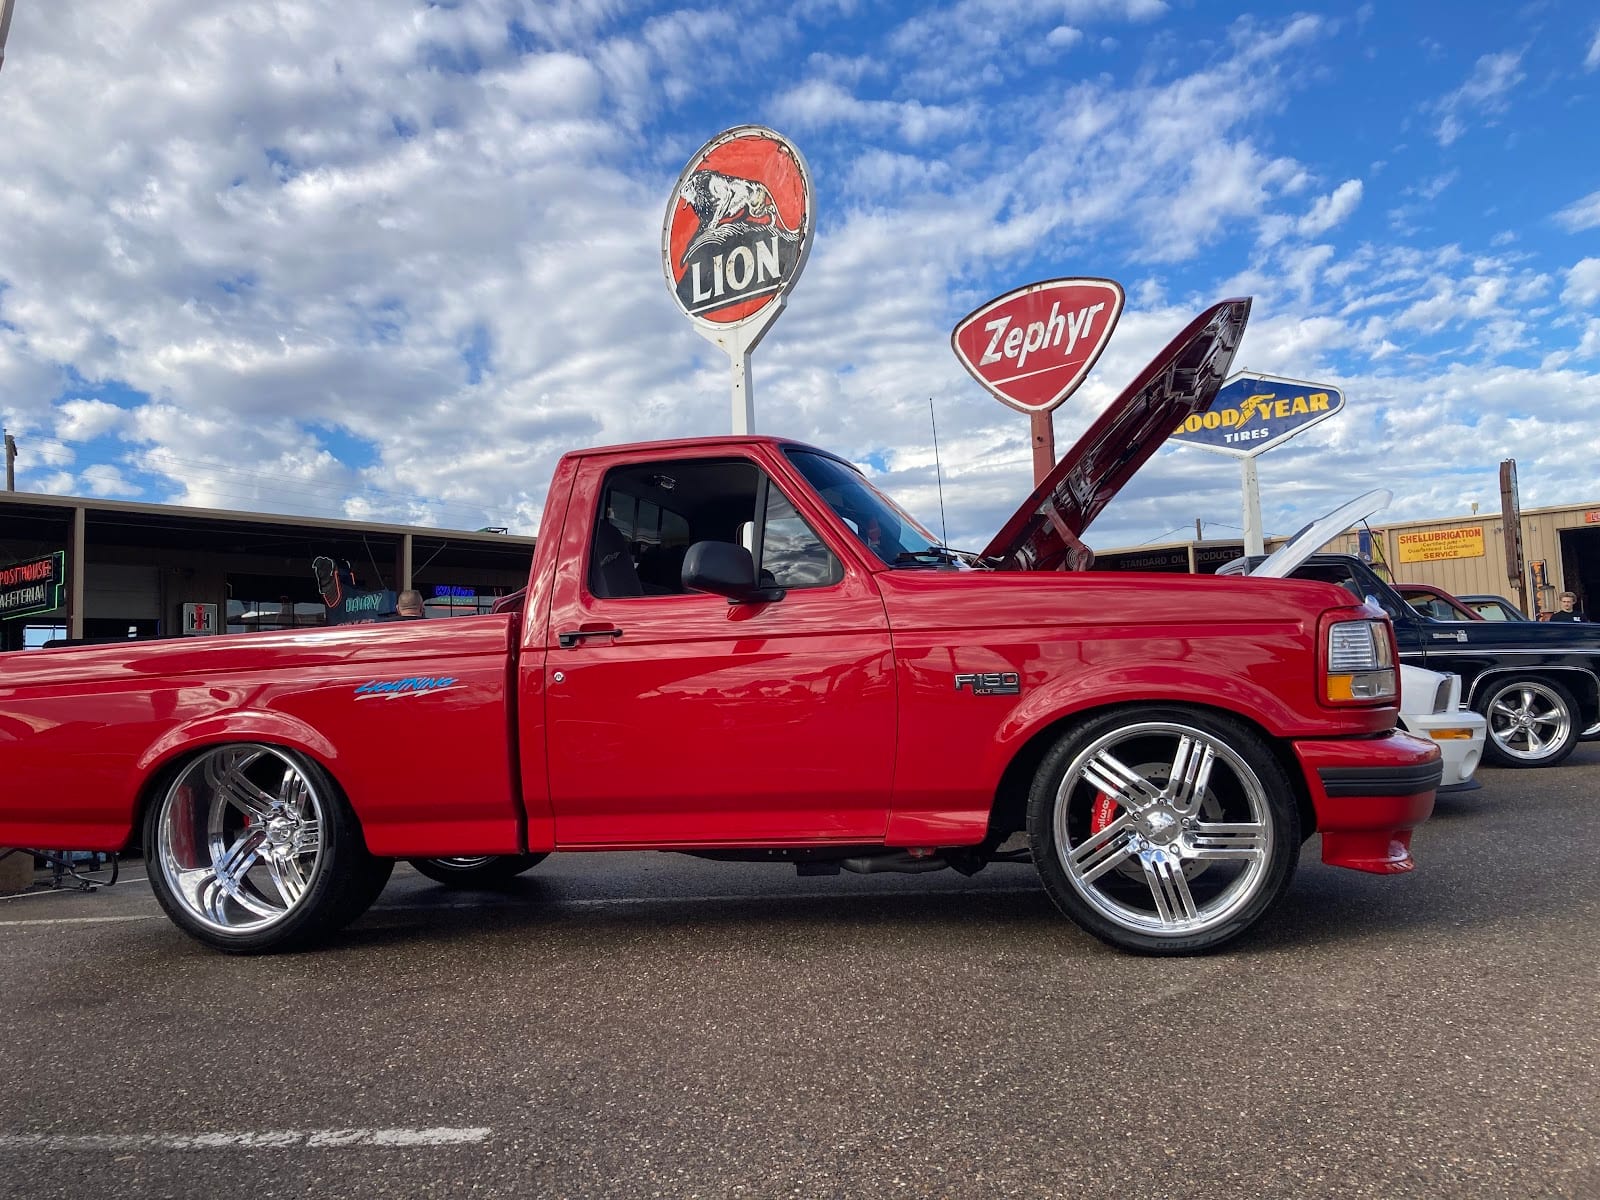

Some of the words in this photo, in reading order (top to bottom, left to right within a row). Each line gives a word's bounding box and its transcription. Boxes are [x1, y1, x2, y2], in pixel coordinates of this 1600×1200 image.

[692, 236, 781, 303] LION
[979, 302, 1105, 368] Zephyr
[1224, 428, 1269, 443] TIRES
[1120, 556, 1167, 569] STANDARD
[1171, 554, 1187, 564] OIL
[1197, 549, 1241, 561] RODUCTS
[1423, 551, 1459, 559] SERVICE
[0, 584, 44, 608] AFETERIA
[346, 593, 382, 612] DAIRY
[354, 677, 458, 693] LIGHTNING
